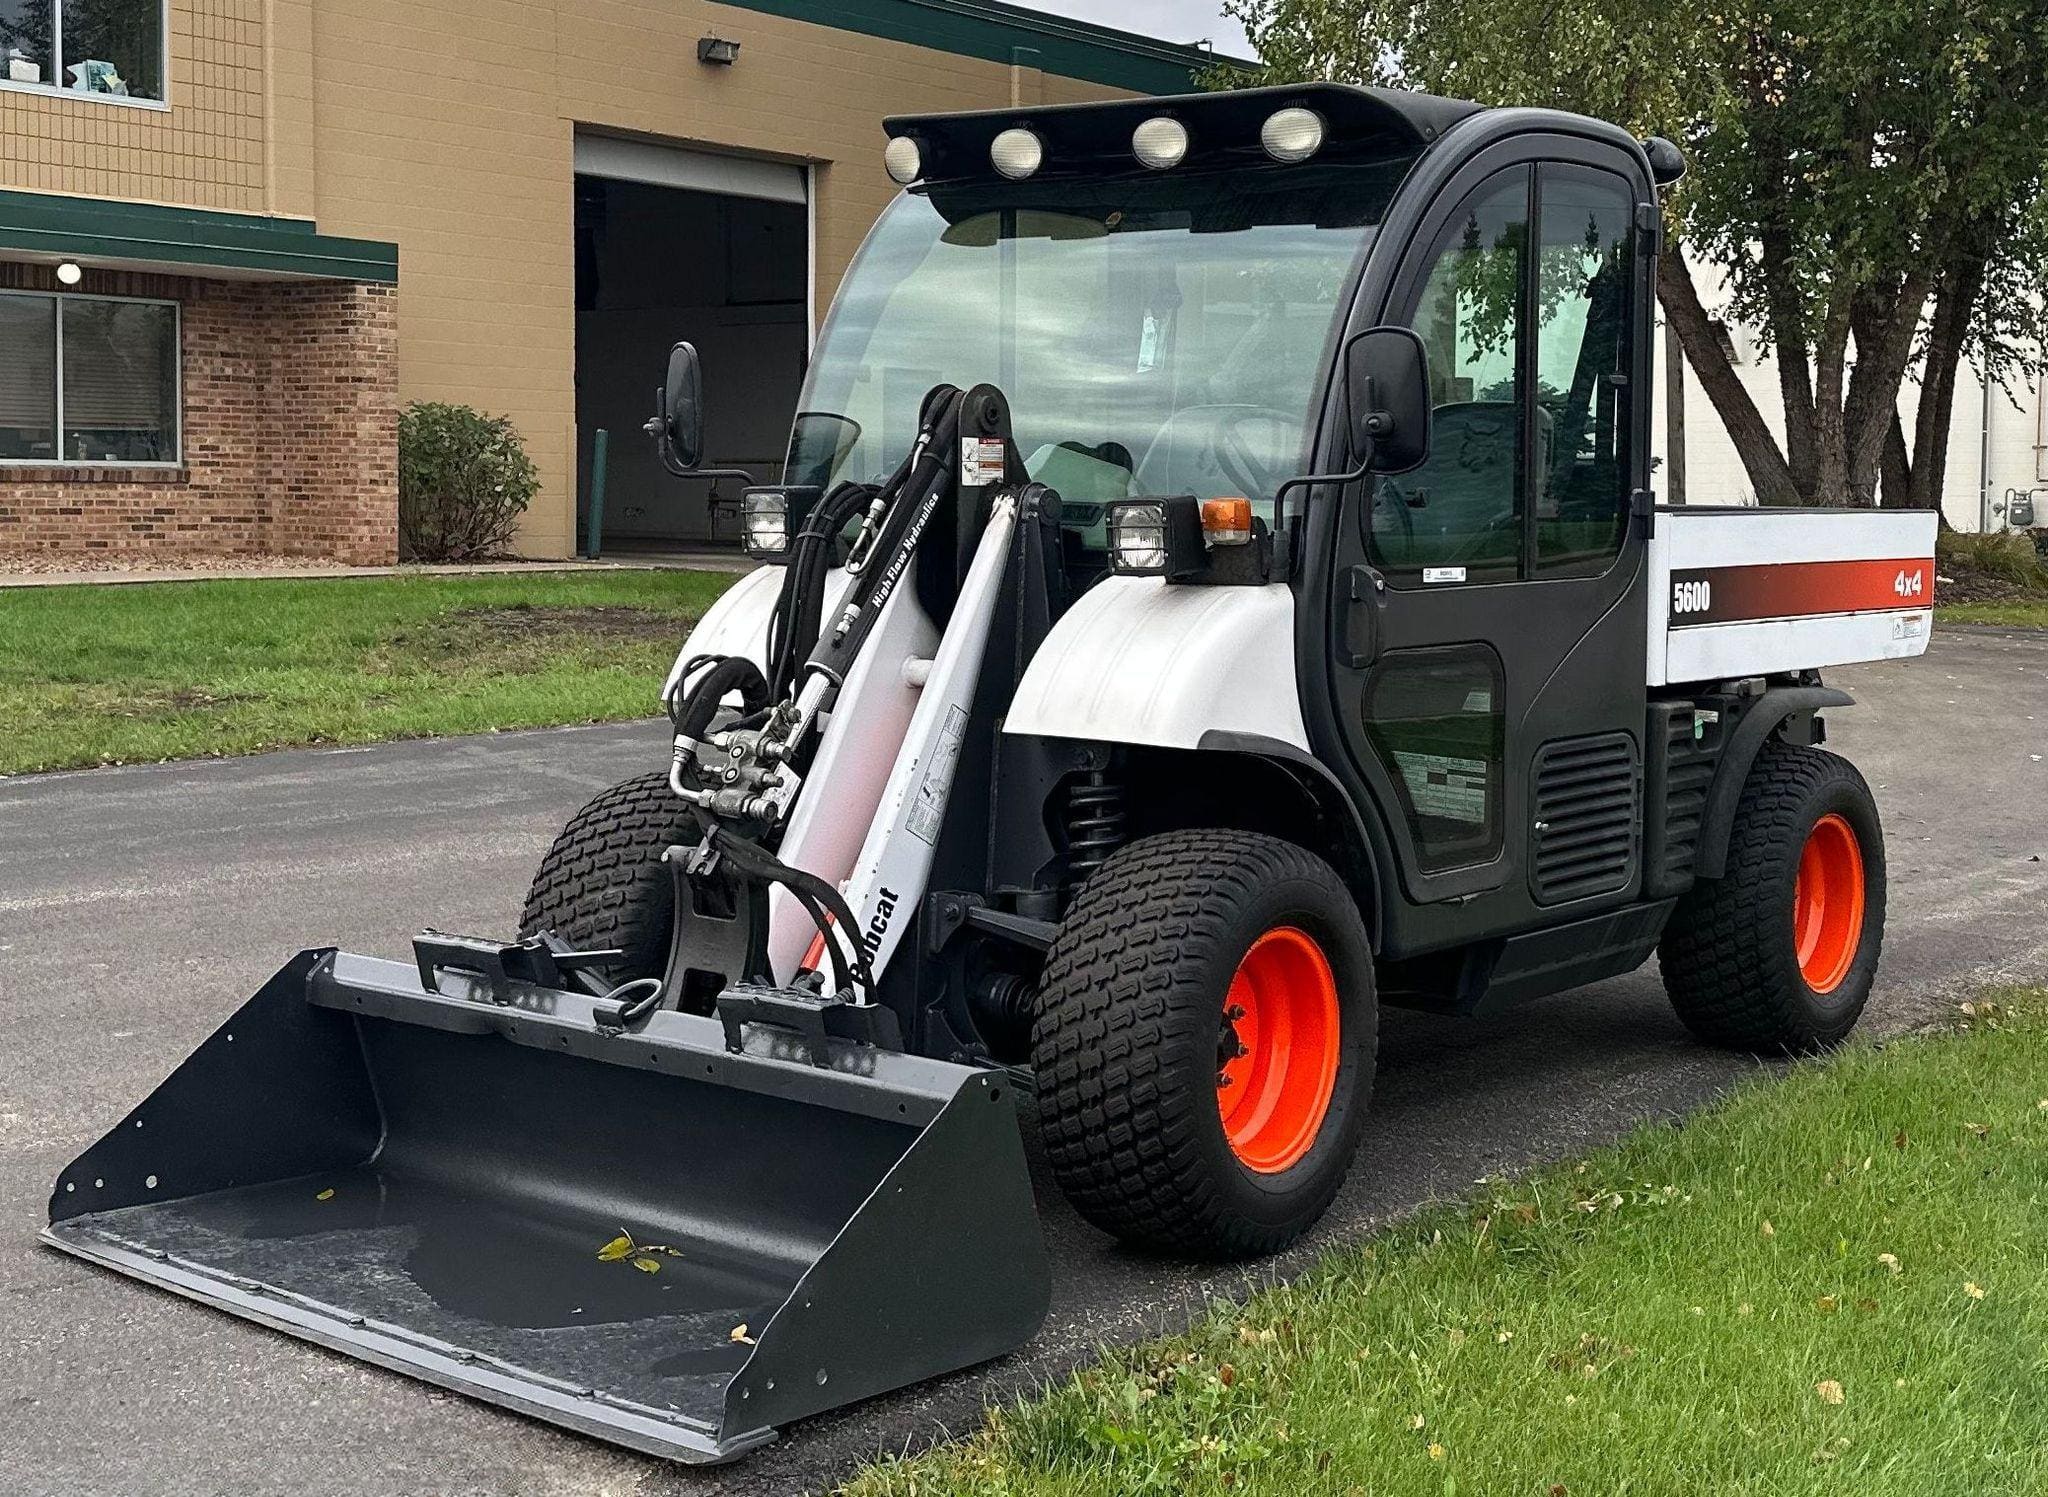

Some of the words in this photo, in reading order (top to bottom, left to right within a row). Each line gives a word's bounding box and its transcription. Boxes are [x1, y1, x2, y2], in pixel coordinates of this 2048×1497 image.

[872, 579, 892, 608] High
[887, 551, 907, 580] Flow
[903, 493, 939, 551] Hydraulics
[1674, 581, 1710, 613] 5600
[1894, 569, 1922, 597] 4x4
